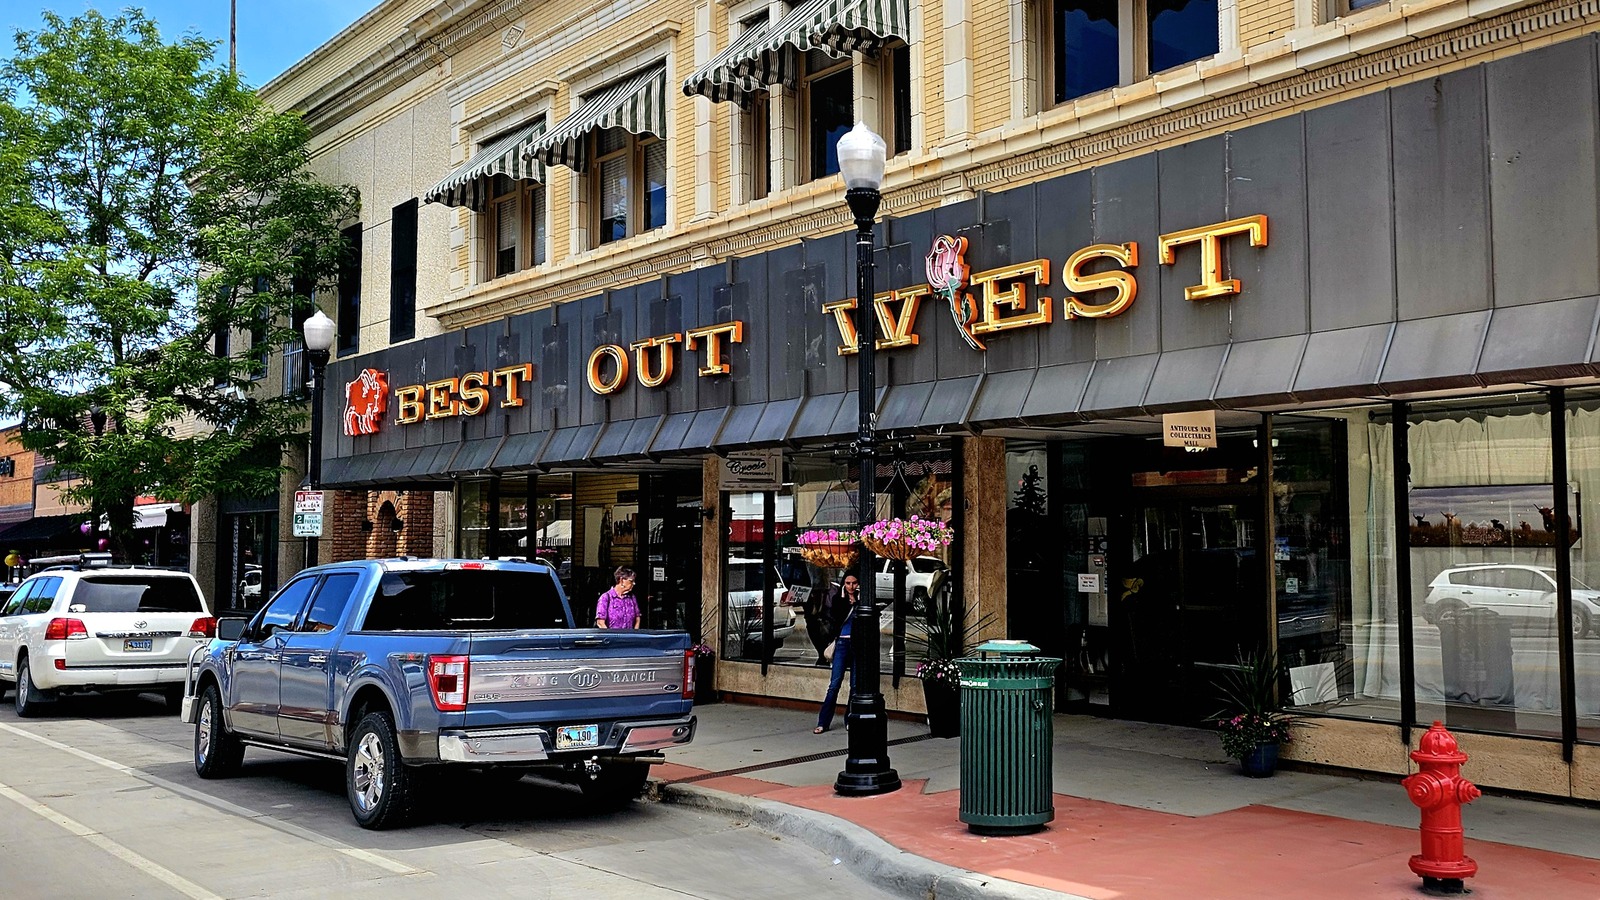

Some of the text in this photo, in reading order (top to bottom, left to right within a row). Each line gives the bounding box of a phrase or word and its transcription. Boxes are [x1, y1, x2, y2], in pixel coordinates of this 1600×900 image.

[395, 214, 1268, 425] BEST OUT WEST
[297, 515, 303, 524] 2
[510, 671, 656, 688] KING RANCH
[577, 730, 592, 742] 190
